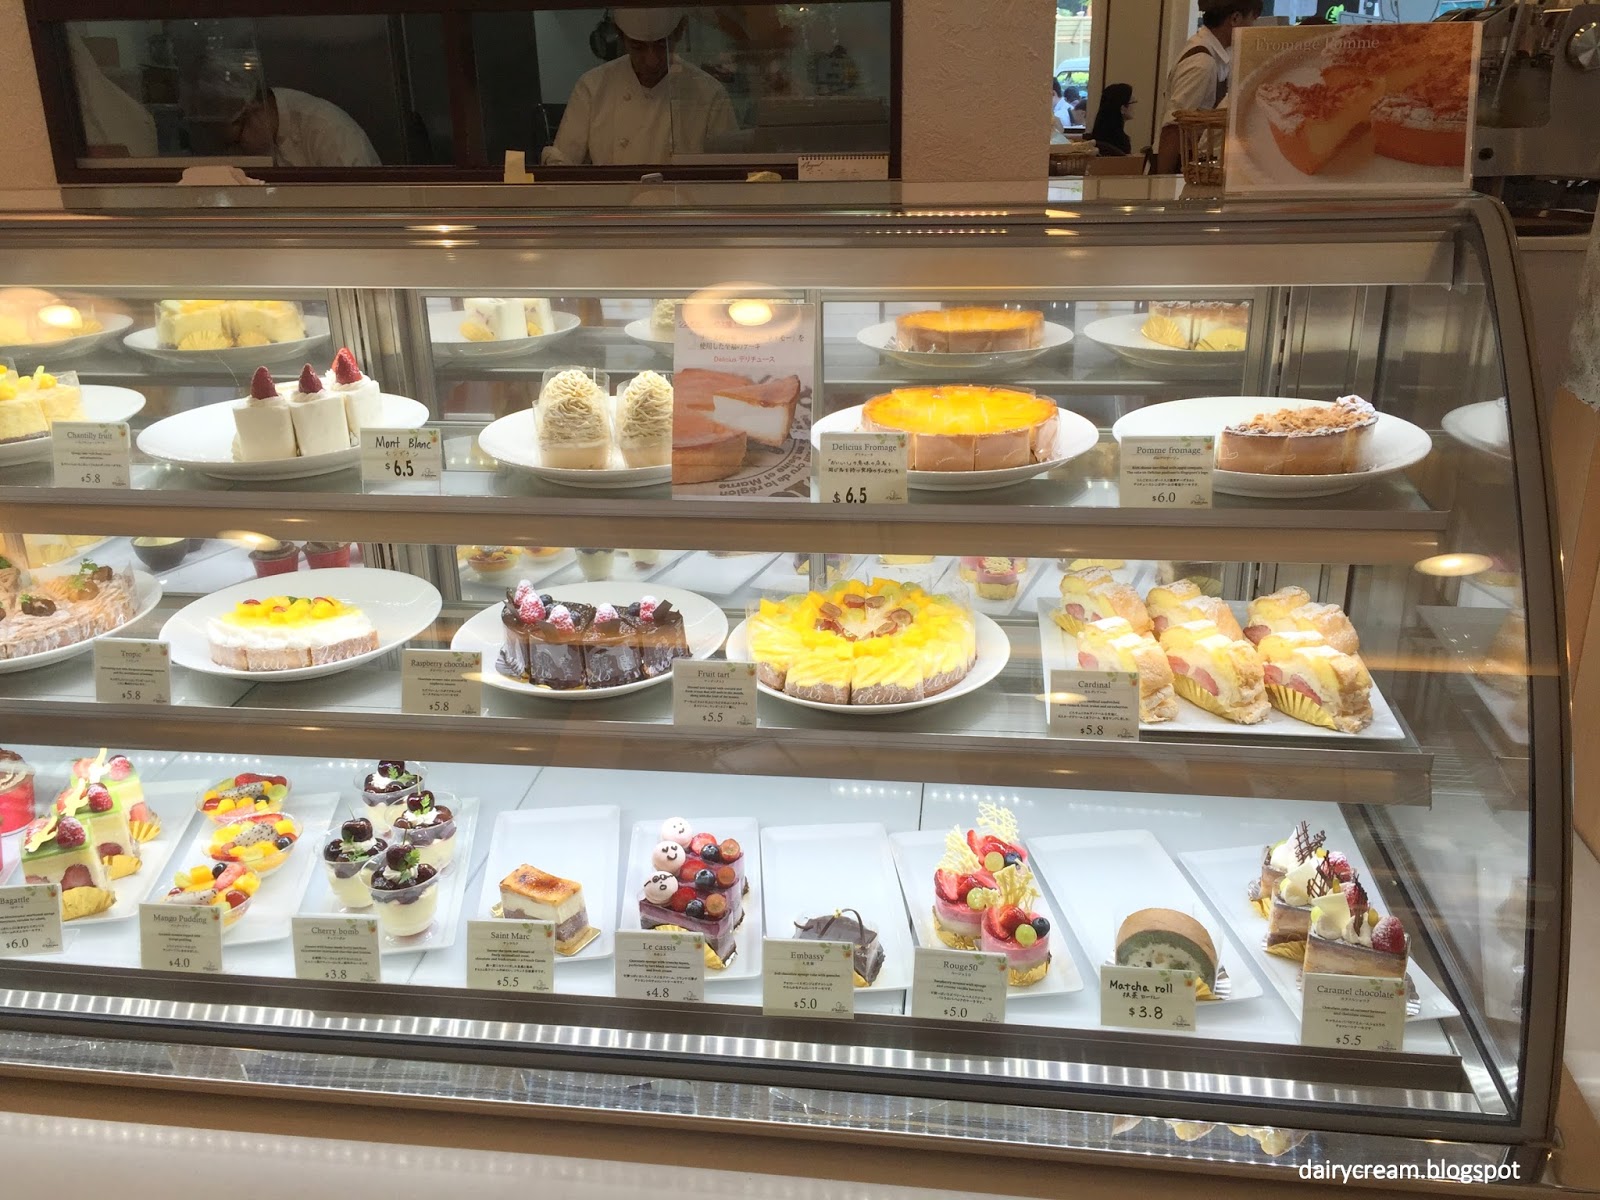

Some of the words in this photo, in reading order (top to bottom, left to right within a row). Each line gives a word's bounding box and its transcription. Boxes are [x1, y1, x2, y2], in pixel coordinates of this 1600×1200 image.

[1256, 38, 1321, 51] Fromage
[1325, 38, 1380, 49] Pomme
[67, 431, 97, 440] Chantilly
[375, 435, 400, 449] Mont
[408, 437, 432, 450] Blanc
[832, 443, 863, 451] Delicius
[864, 443, 897, 452] Fromage
[1136, 446, 1167, 454] Pomme
[1168, 446, 1201, 456] fromage
[81, 473, 101, 484] $5.8
[1152, 491, 1176, 503] $6.0
[411, 659, 442, 669] Raspberry
[443, 661, 474, 669] chocolate
[697, 669, 716, 678] Fruit
[1077, 680, 1111, 689] Cardinal
[429, 701, 450, 711] $5.8
[702, 712, 724, 723] $5.5
[1080, 724, 1104, 736] $5.8
[153, 914, 177, 923] Mango
[178, 915, 207, 925] Pudding
[311, 926, 337, 935] Cherry
[490, 931, 510, 939] Saint
[511, 932, 531, 940] Marc
[6, 937, 29, 949] $6.0
[642, 942, 653, 951] Le
[790, 951, 825, 961] Embassy
[169, 957, 190, 968] $4.0
[943, 960, 978, 972] Rouge50
[325, 969, 347, 980] $3.8
[497, 976, 519, 987] $5.5
[1109, 979, 1150, 993] Matcha
[1155, 983, 1173, 994] roll
[646, 987, 670, 998] $4.8
[1316, 985, 1353, 996] Caramel
[1354, 988, 1395, 999] chocolate
[794, 998, 818, 1009] $5.0
[944, 1006, 968, 1018] $5.0
[1335, 1034, 1362, 1046] $5.5
